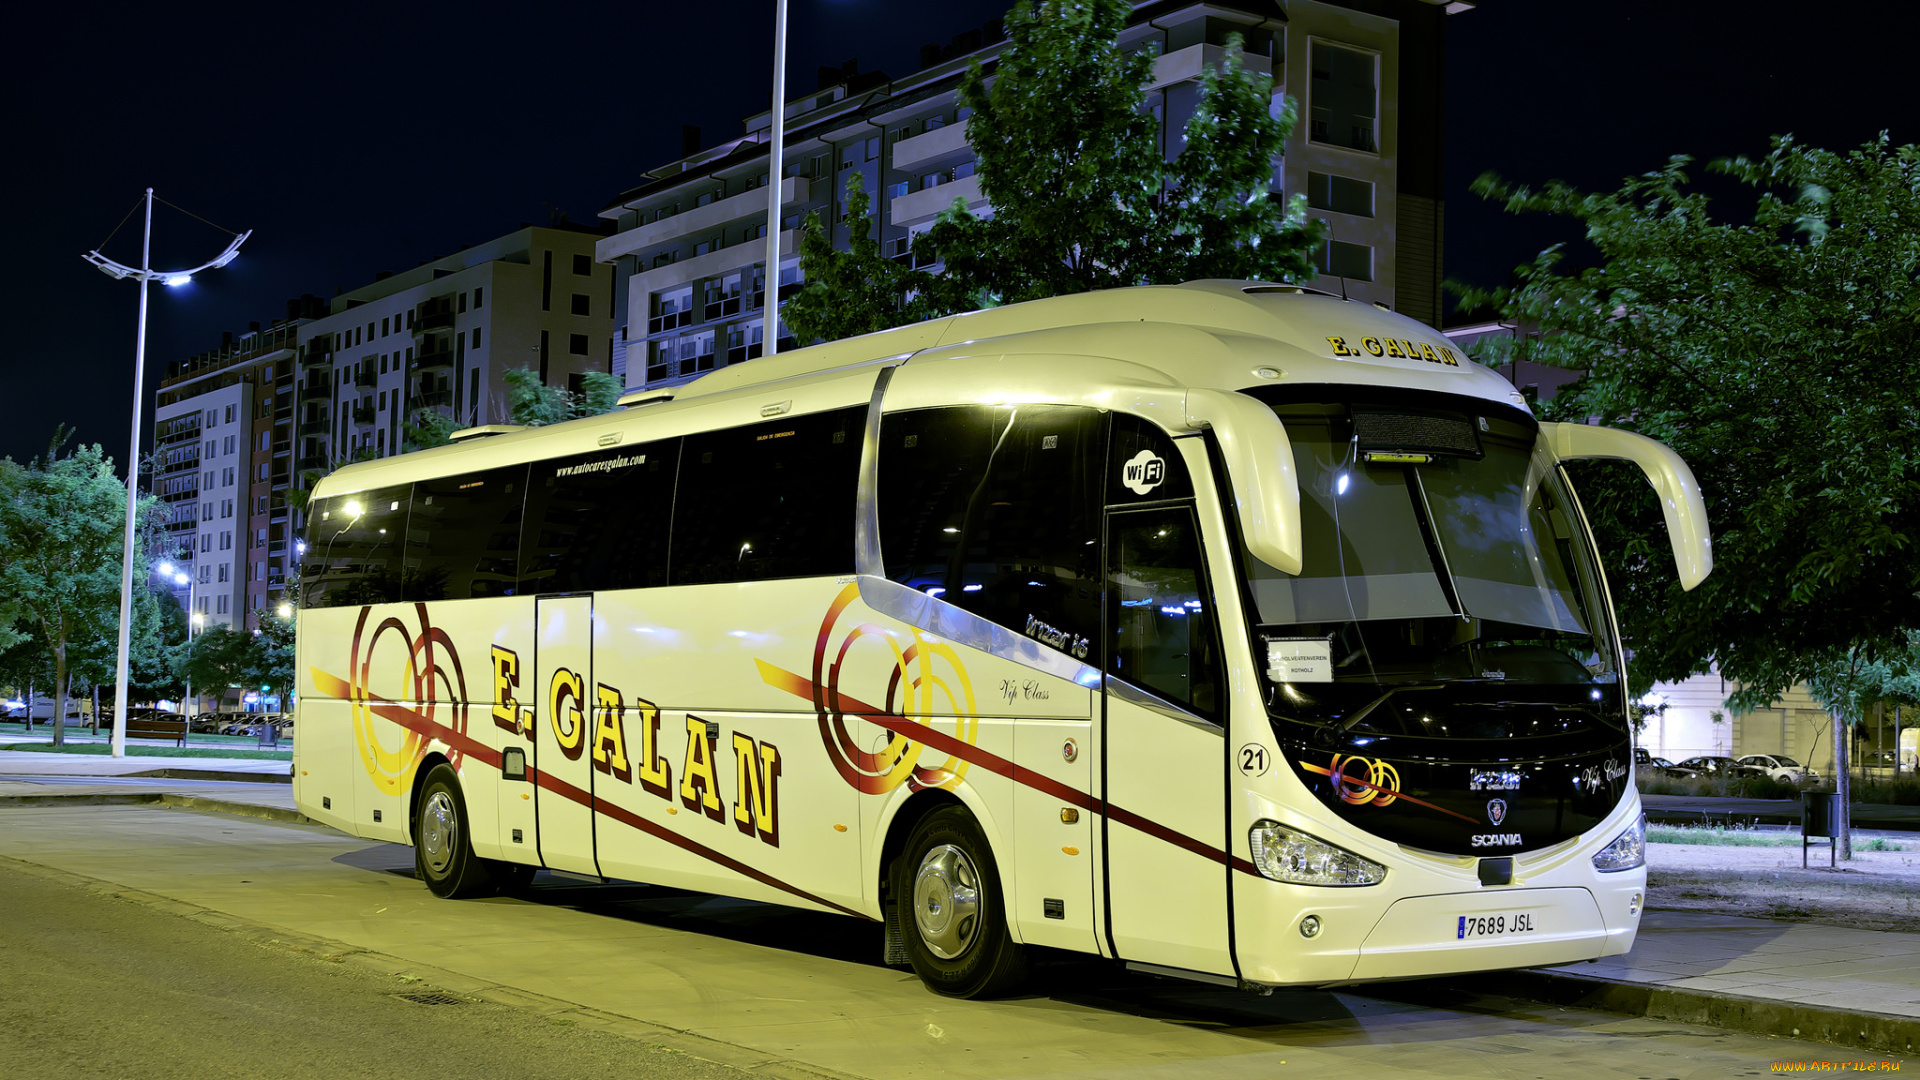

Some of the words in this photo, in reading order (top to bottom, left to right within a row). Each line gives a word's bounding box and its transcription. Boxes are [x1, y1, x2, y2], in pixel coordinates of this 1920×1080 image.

[1326, 336, 1361, 356] E.
[1361, 336, 1459, 367] GALAN
[556, 454, 646, 478] www.autocaresgalan.com
[999, 679, 1018, 705] Vip
[1022, 679, 1049, 700] Class
[491, 644, 535, 742] E.
[549, 667, 781, 848] GALAN
[1243, 748, 1264, 770] 21
[1604, 758, 1626, 781] Class
[1471, 833, 1523, 847] SCANIA
[1468, 916, 1505, 936] 7689
[1509, 913, 1534, 933] JSL
